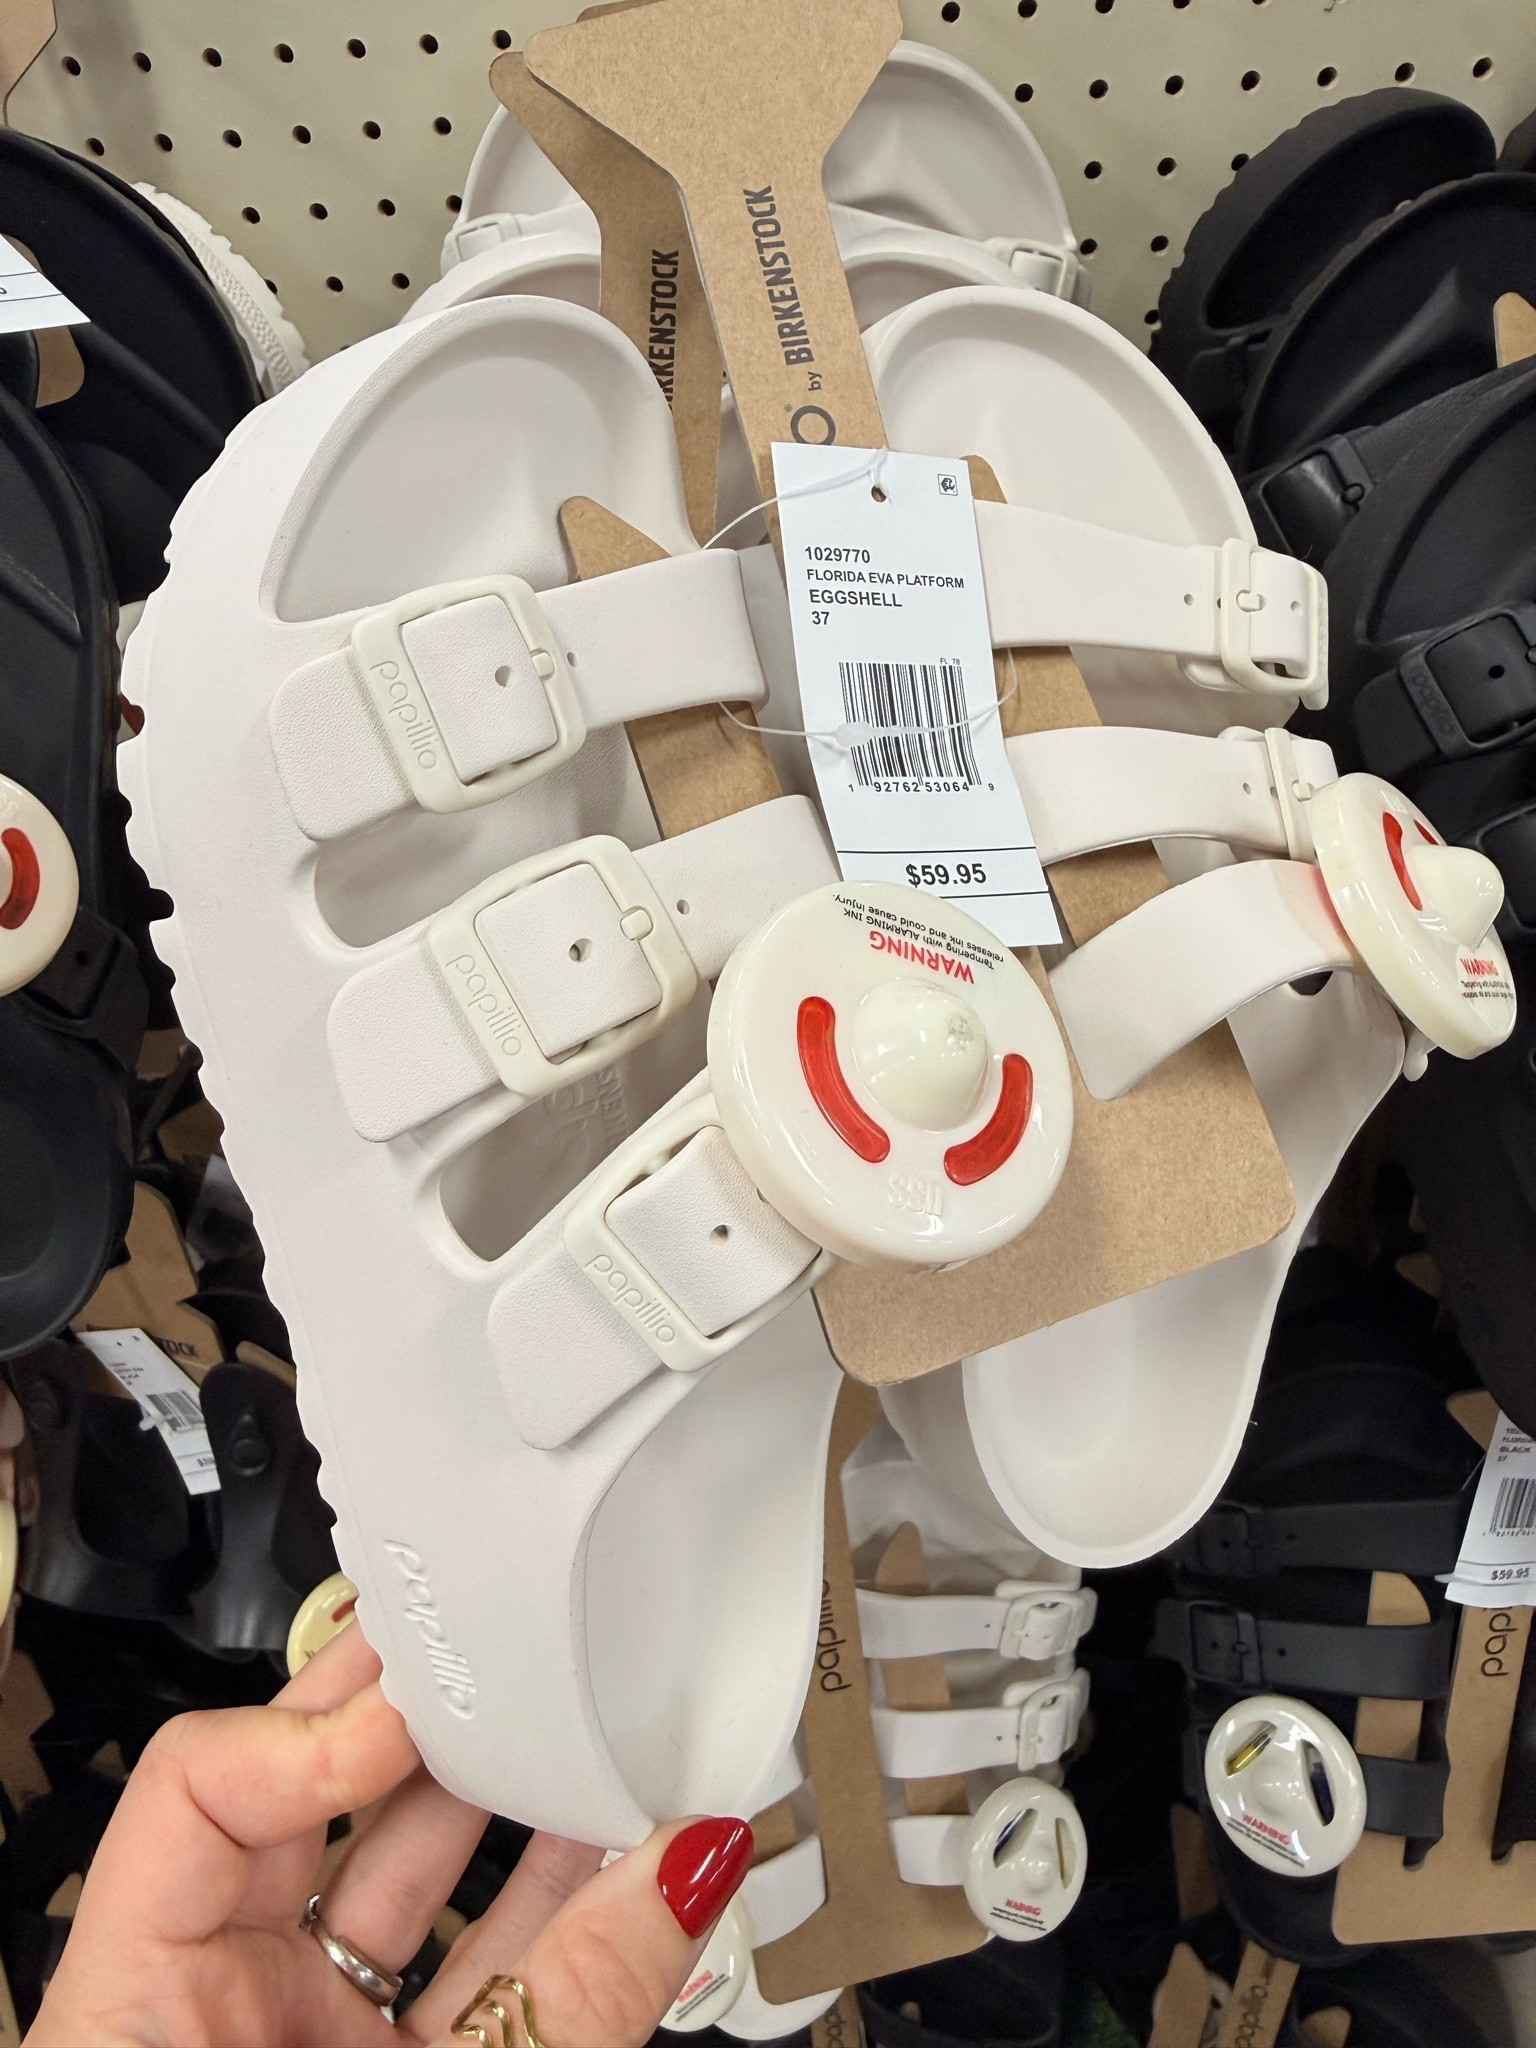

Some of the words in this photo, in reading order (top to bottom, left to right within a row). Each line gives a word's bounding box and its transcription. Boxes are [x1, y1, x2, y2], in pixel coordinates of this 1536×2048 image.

[743, 185, 814, 366] BIRKENSTOCK
[648, 249, 679, 410] RKENSTOCK
[808, 371, 822, 391] by
[805, 546, 871, 563] 1029770
[807, 569, 866, 583] FLORIDA
[869, 572, 894, 585] EVA
[897, 574, 965, 588] PLATFORM
[809, 589, 902, 607] EGGSHELL
[811, 611, 830, 625] 37
[370, 660, 439, 770] papillio
[874, 782, 920, 792] 92762
[925, 782, 970, 792] 53064
[905, 863, 987, 887] $59.95
[832, 894, 865, 912] injury.
[843, 908, 863, 921] INK
[868, 906, 897, 921] cause
[866, 916, 920, 940] ALARMING
[900, 917, 926, 932] could
[929, 928, 947, 940] and
[923, 935, 943, 948] with
[949, 935, 964, 948] ink
[869, 930, 975, 985] WARNING
[946, 943, 994, 970] Tampering
[966, 942, 1004, 963] releases
[444, 953, 522, 1057] papillio
[583, 1254, 676, 1344] papillio
[385, 1539, 477, 1720] papillio
